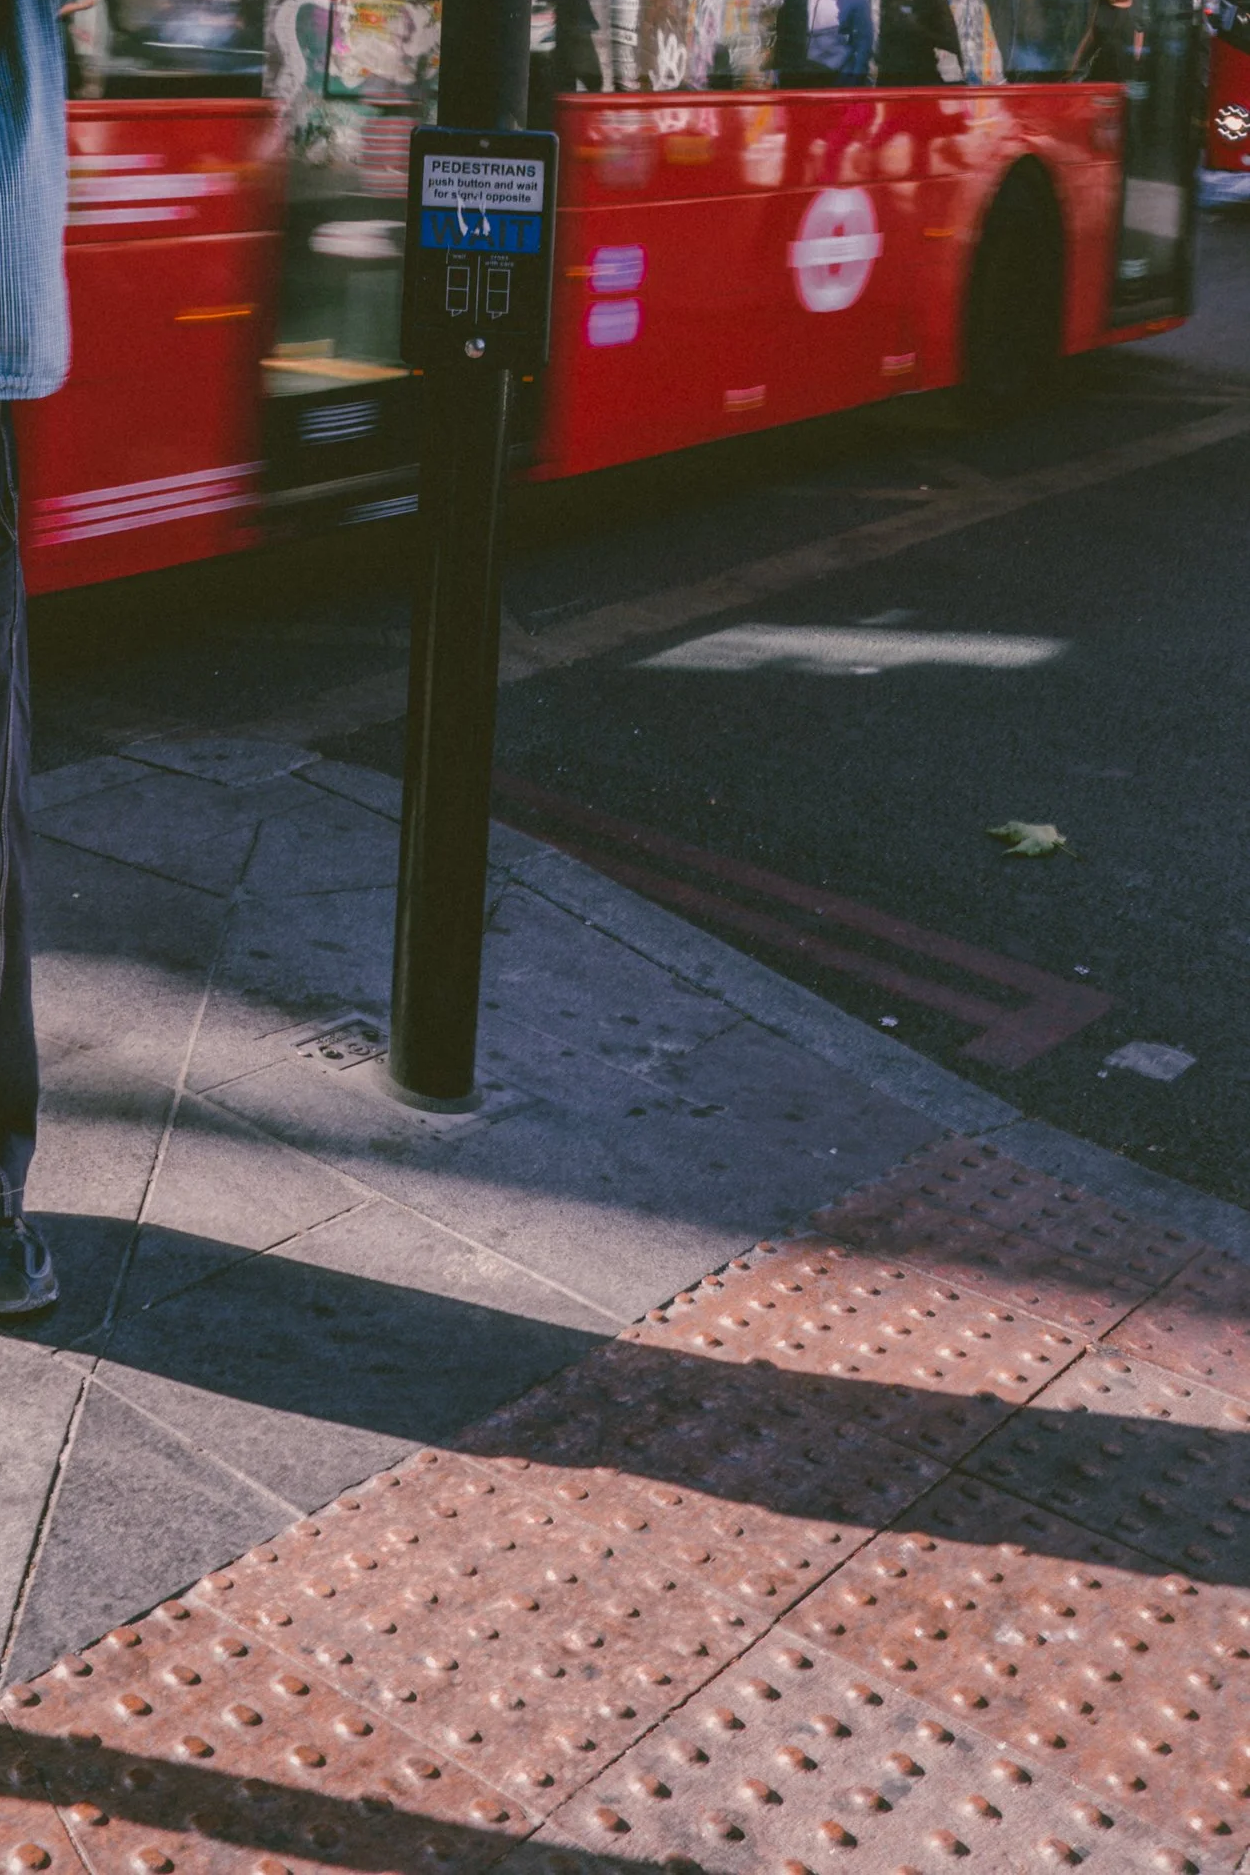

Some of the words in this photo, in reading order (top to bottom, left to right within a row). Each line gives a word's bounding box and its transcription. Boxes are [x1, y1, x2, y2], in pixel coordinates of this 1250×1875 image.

[432, 160, 536, 177] PEDESTRIANS
[428, 177, 454, 188] push
[457, 177, 491, 189] button
[494, 180, 514, 190] and
[516, 182, 538, 191] wait
[433, 188, 448, 199] for
[485, 193, 531, 204] opposite
[430, 214, 533, 248] WAIT
